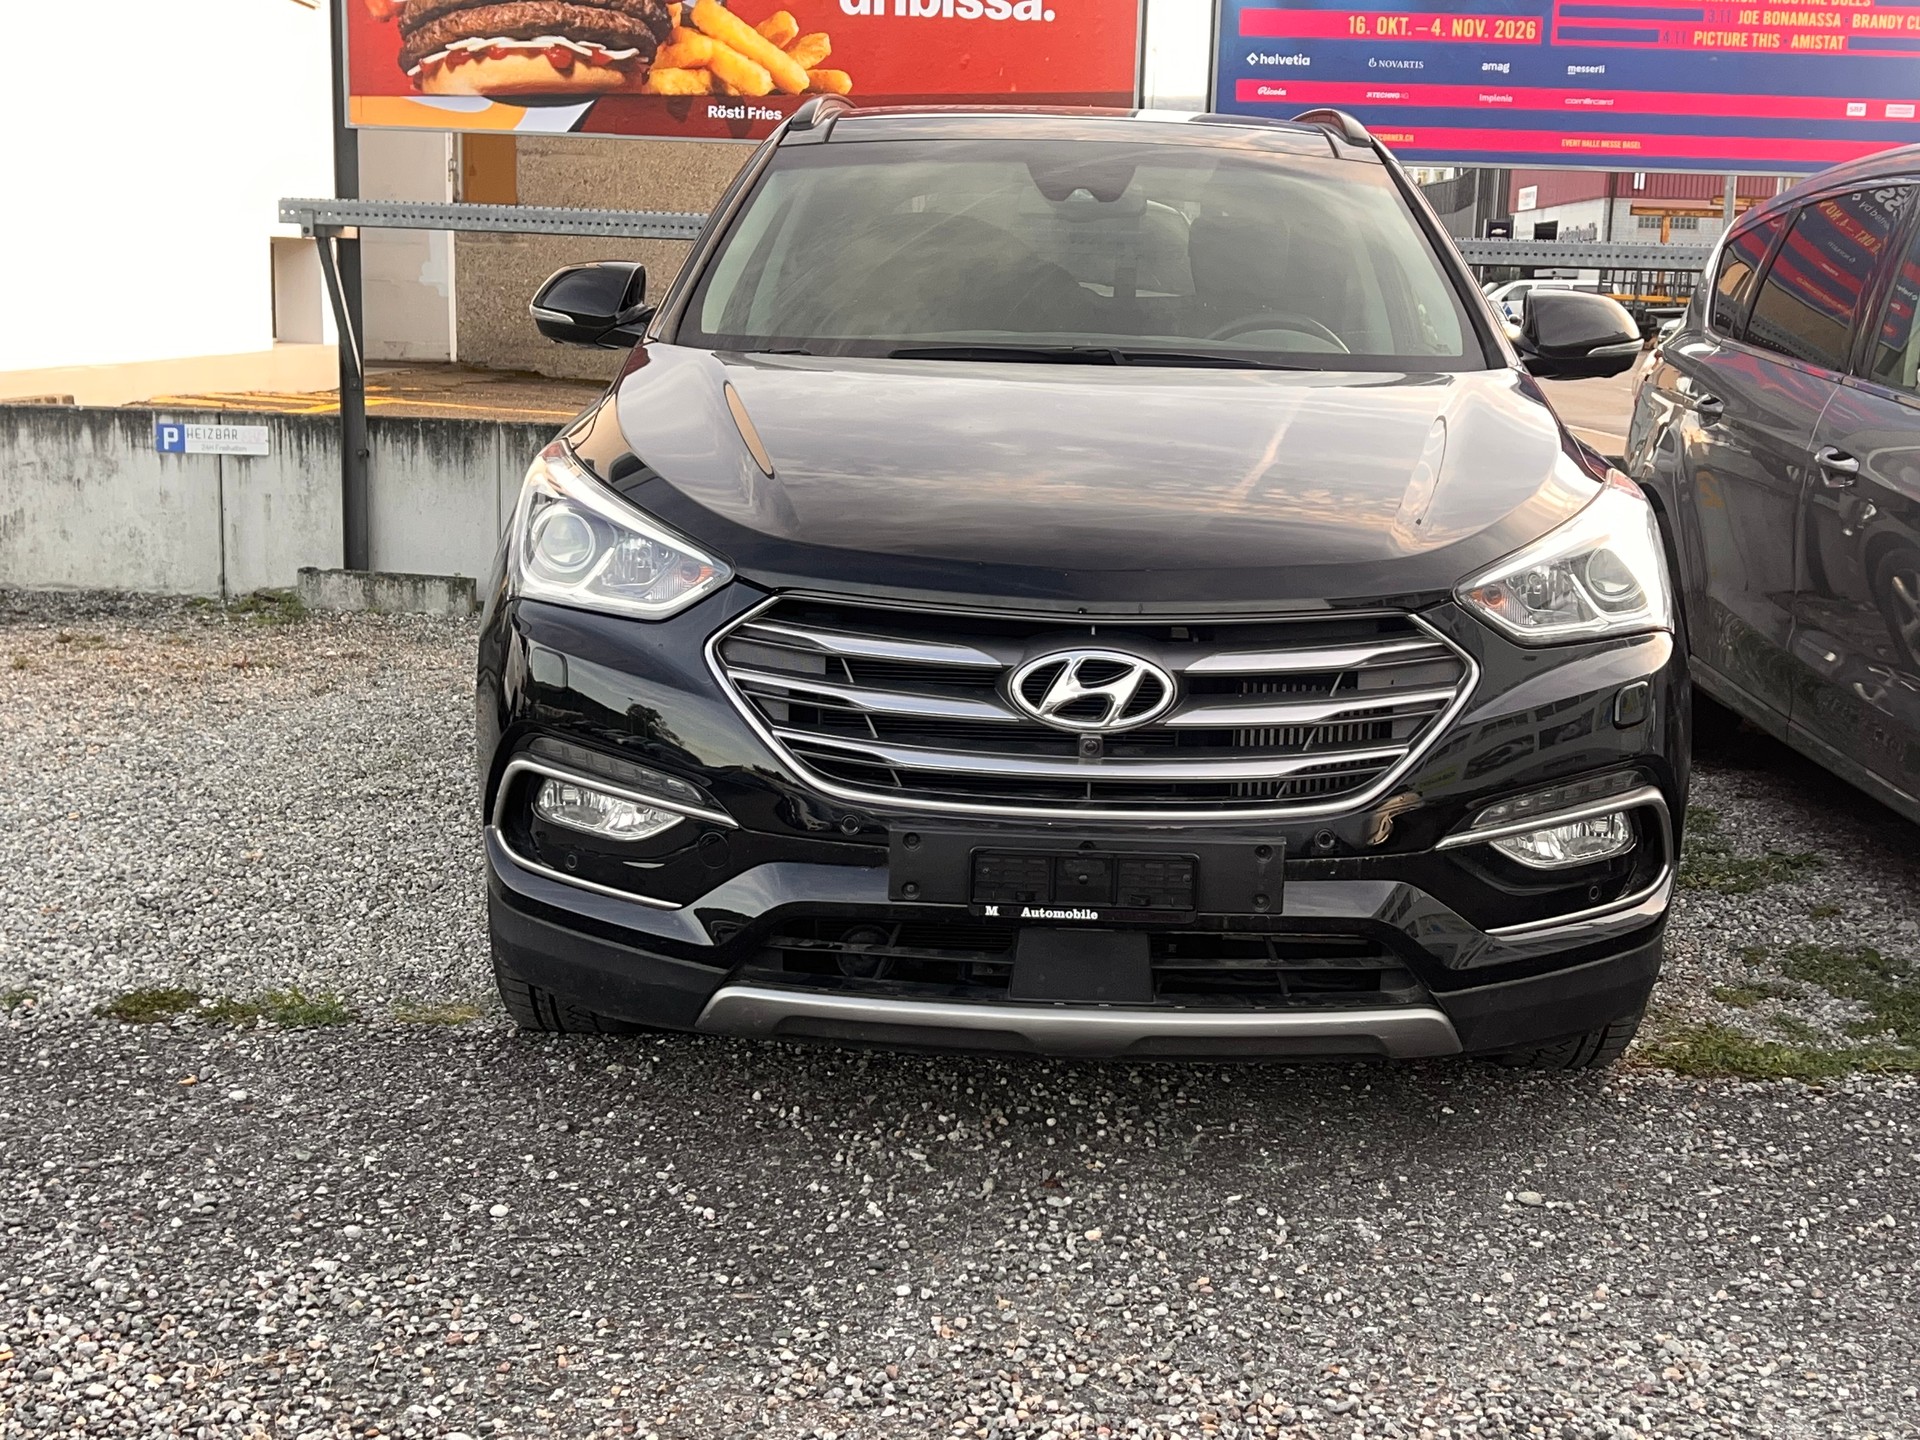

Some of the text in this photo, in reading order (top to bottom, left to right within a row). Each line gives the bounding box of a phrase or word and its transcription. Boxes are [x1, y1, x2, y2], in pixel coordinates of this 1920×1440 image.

[1738, 10, 1760, 25] JOE
[1763, 10, 1841, 27] BONAMASSA
[1852, 14, 1904, 29] BRANDY
[1349, 16, 1370, 34] 16.
[1376, 17, 1412, 35] OKT.
[1431, 18, 1446, 36] 4.
[1452, 19, 1489, 38] NOV.
[1494, 20, 1536, 39] 2026
[1693, 31, 1748, 46] PICTURE
[1752, 33, 1780, 48] THIS
[1791, 35, 1845, 50] AMISTAT
[1260, 53, 1310, 65] helvetia
[1378, 60, 1424, 69] NOVARTIS
[1482, 62, 1510, 73] amag
[1568, 64, 1605, 74] messerli
[708, 105, 782, 120] Rösti Fries
[1562, 139, 1580, 147] EVENT
[985, 906, 1098, 920] M Automobile
